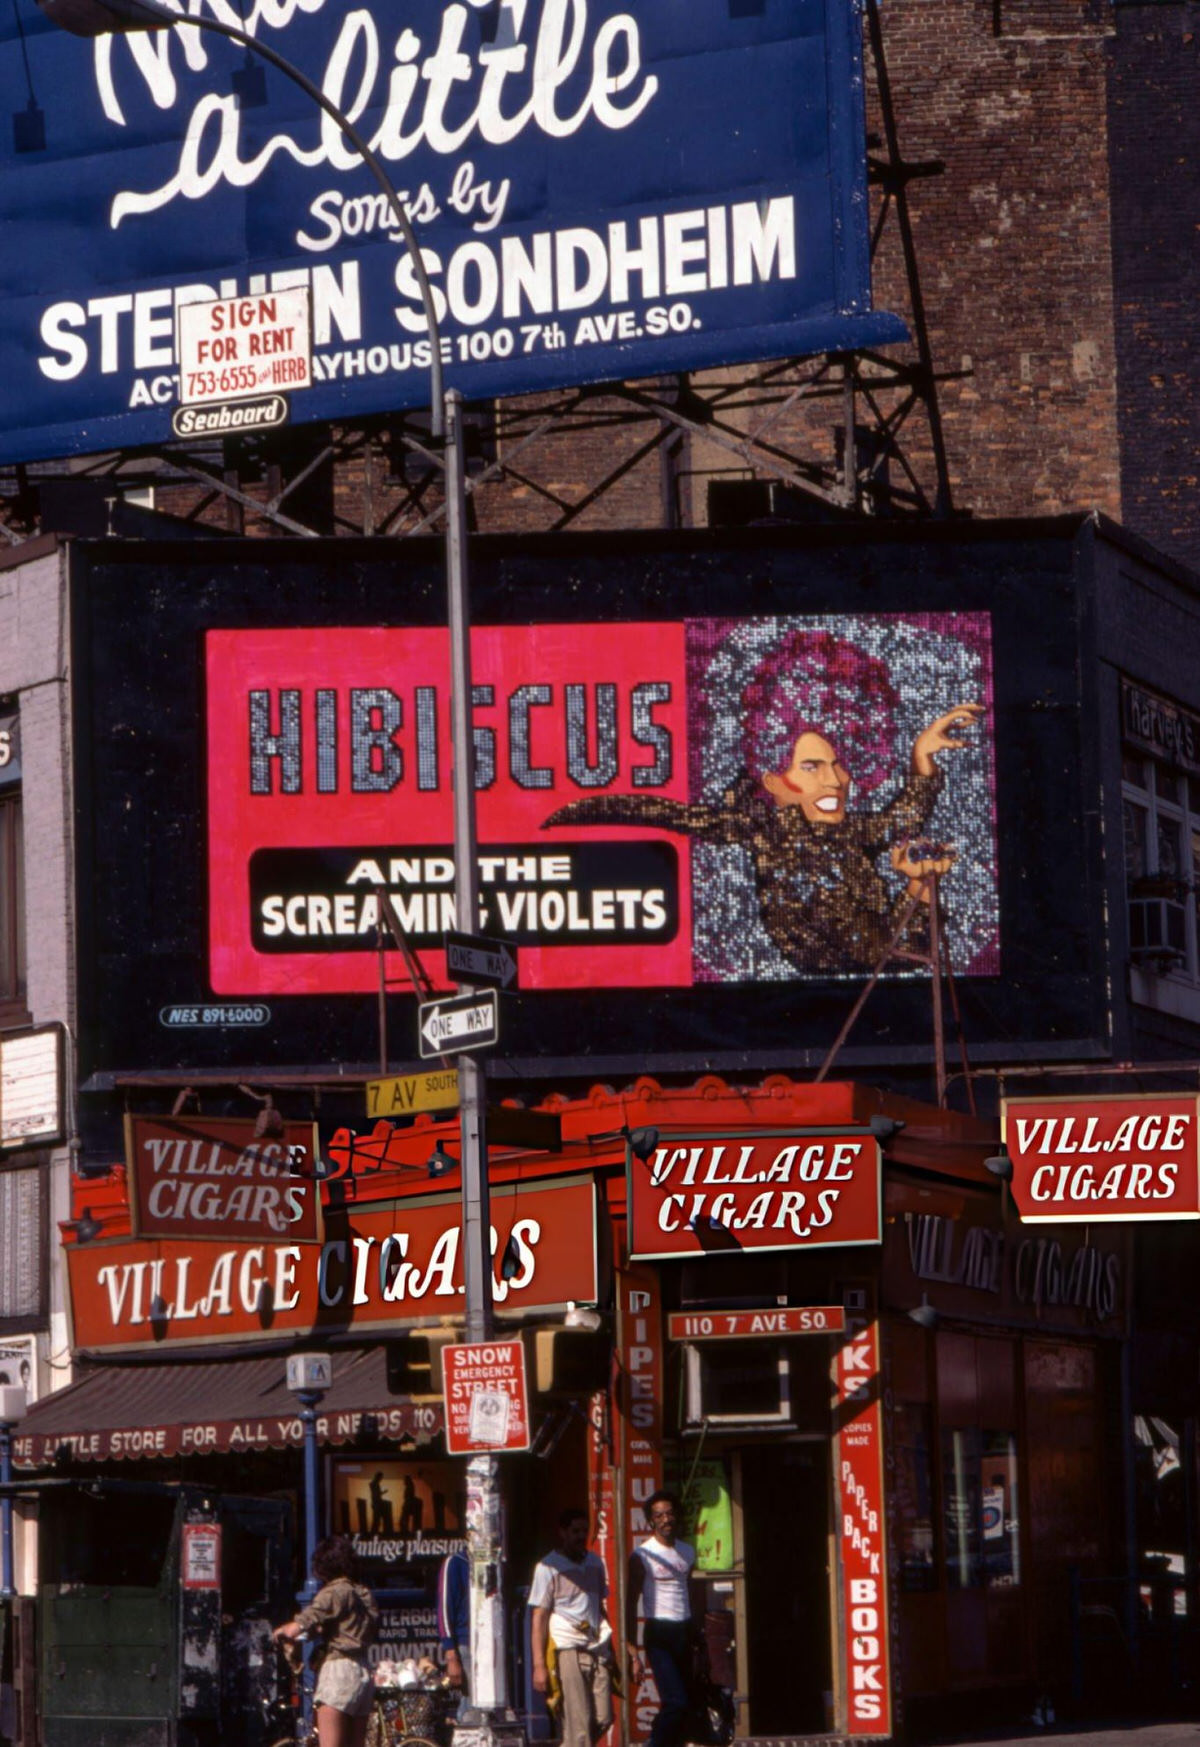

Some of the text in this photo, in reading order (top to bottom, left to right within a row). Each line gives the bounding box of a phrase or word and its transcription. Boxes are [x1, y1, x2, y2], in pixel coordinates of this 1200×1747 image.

[296, 161, 510, 251] Songs by
[37, 195, 796, 381] STEN SONDHEIM
[211, 298, 277, 332] SIGN
[198, 327, 295, 364] FOR RENT
[457, 327, 504, 362] 100
[520, 321, 566, 352] 7th
[187, 365, 257, 397] 753-6555
[272, 357, 307, 385] HERB
[180, 400, 279, 433] Seaboard
[346, 855, 572, 884] AND THE
[260, 889, 667, 938] SCREAMIN VIOLETS
[452, 947, 509, 976] ONE WAY
[430, 1007, 491, 1038] ONE WAY
[370, 1074, 458, 1113] 7 AV SOUTH
[1015, 1115, 1191, 1155] VILLAGE
[144, 1139, 307, 1178] VILLAGE
[650, 1144, 862, 1187] VILLAGE
[1030, 1163, 1178, 1201] CIGARS
[148, 1179, 306, 1232] CIGARS
[658, 1190, 840, 1237] CIGARS
[98, 1246, 301, 1326] VILLAGE
[684, 1317, 713, 1336] 110
[726, 1316, 737, 1334] 7
[454, 1347, 512, 1366] SNOW
[454, 1365, 515, 1380] EMERGENCY
[13, 1438, 33, 1456] HE
[110, 1430, 166, 1453] STORE
[182, 1426, 217, 1446] FOR
[229, 1421, 269, 1444] ALL
[277, 1417, 329, 1442] YOR
[842, 1461, 877, 1532] PAPER
[844, 1514, 880, 1575] BACK
[850, 1578, 883, 1720] BOOKS
